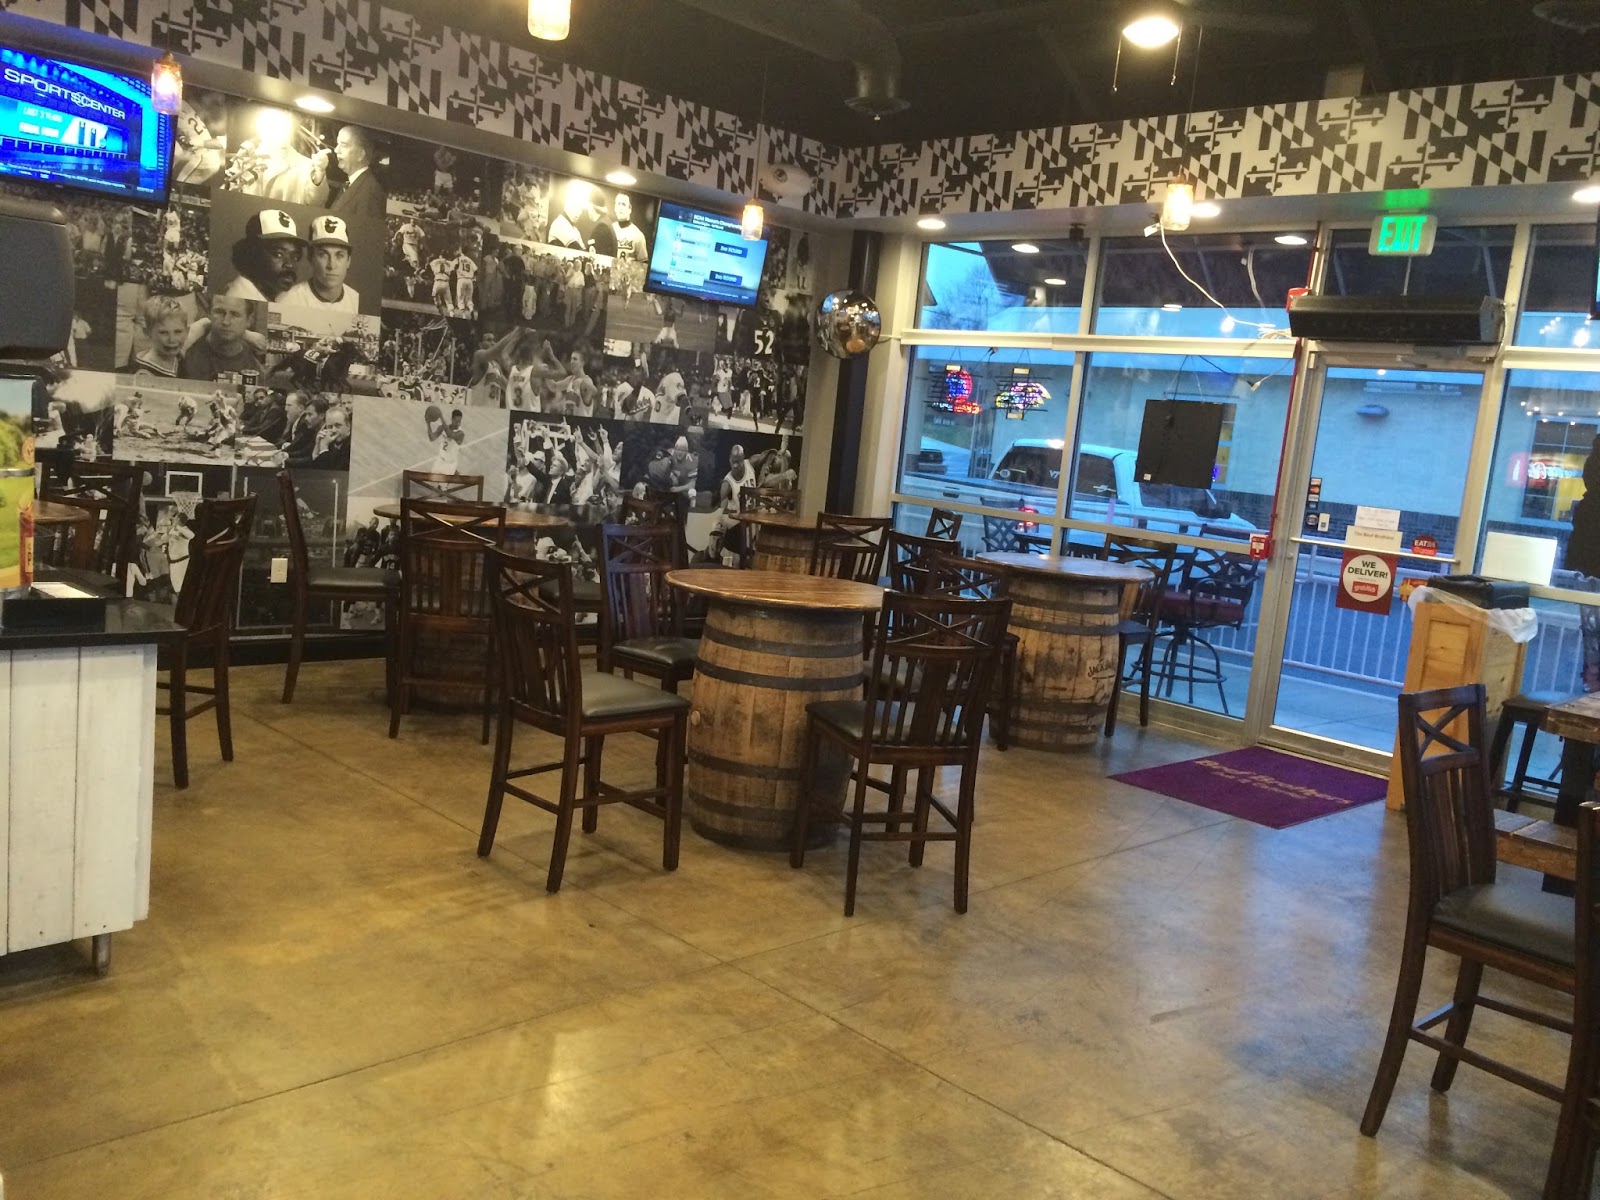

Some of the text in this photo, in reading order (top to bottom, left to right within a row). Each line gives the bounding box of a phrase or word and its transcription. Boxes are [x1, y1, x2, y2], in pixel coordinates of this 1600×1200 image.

[4, 68, 126, 119] SPORTSCENTER
[1377, 215, 1427, 252] EXIT
[754, 330, 774, 355] 52
[1347, 567, 1389, 579] DELIVER!
[1362, 560, 1376, 569] WE
